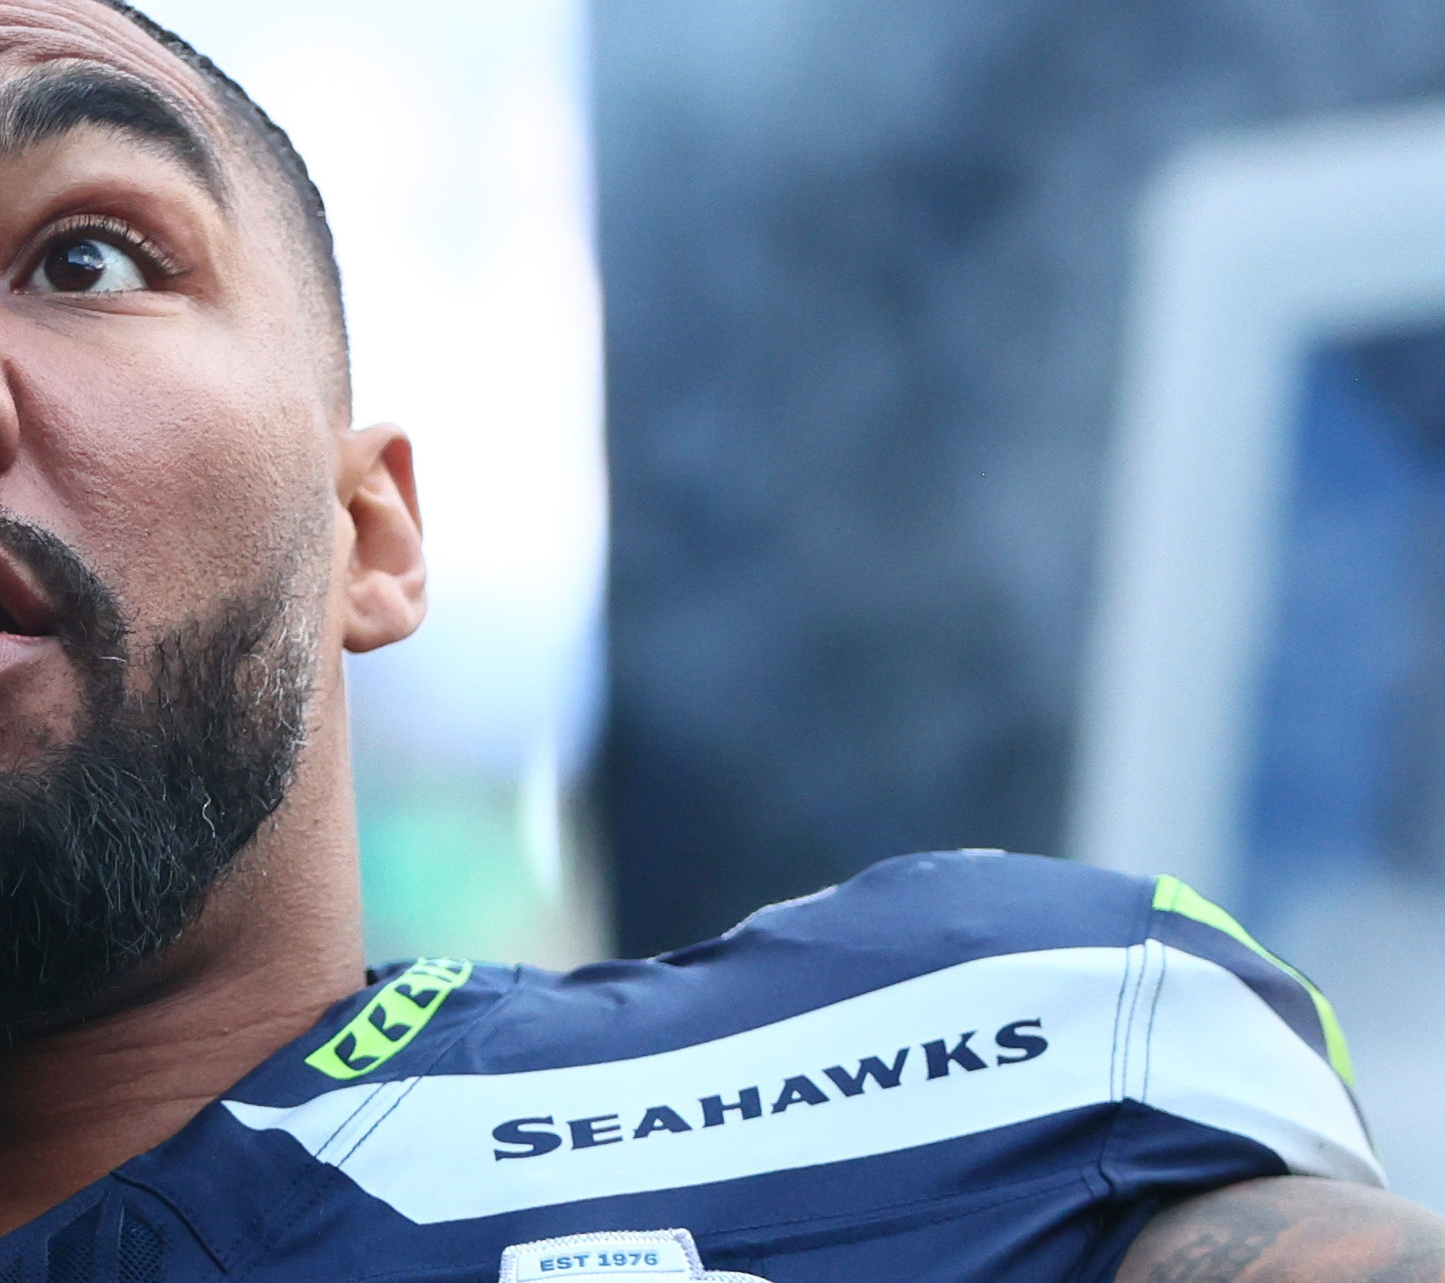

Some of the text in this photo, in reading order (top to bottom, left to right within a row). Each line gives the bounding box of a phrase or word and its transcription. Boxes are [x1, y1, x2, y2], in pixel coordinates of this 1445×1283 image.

[491, 1017, 1050, 1162] SEAHAWKS
[539, 1251, 659, 1272] EST 1976
